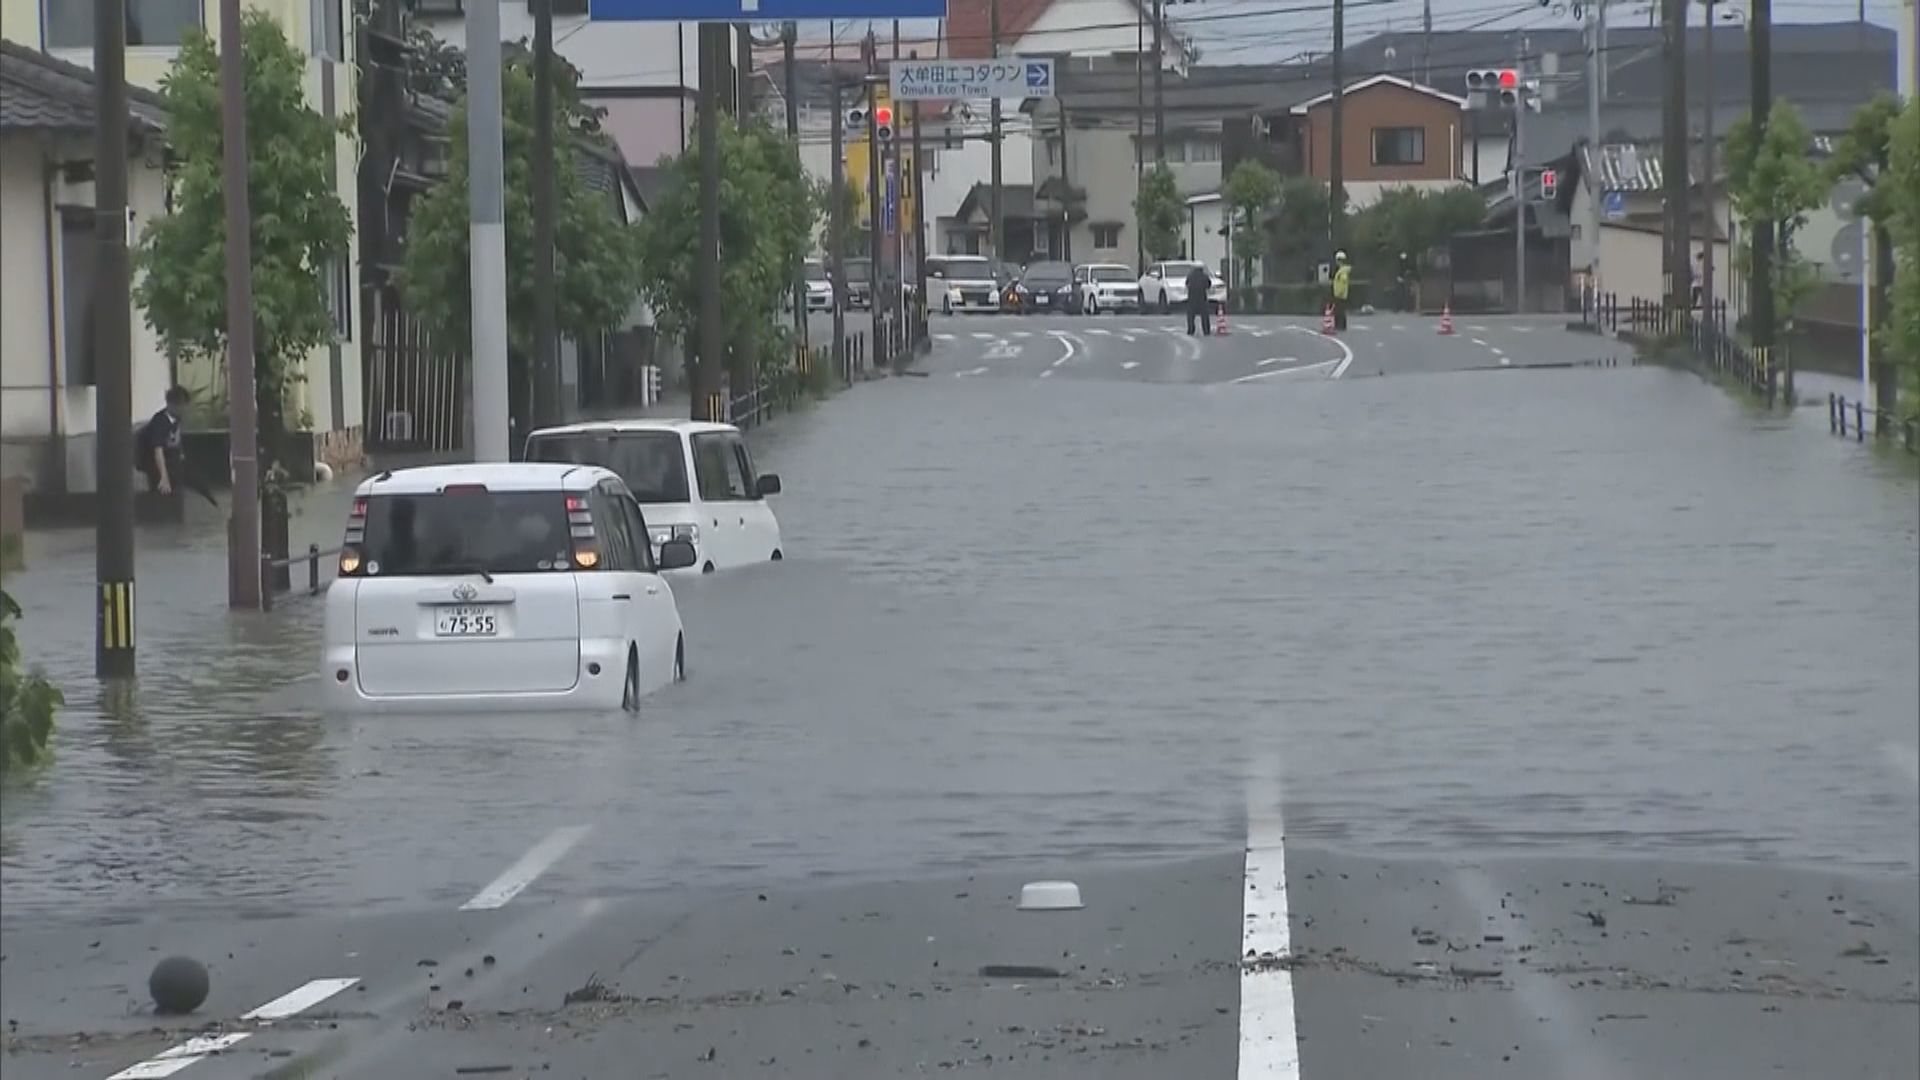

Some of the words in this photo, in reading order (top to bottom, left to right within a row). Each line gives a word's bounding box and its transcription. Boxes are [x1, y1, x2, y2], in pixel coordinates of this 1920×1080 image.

[900, 64, 1022, 83] 大牟田エコタウン
[900, 84, 934, 96] Omuta
[937, 84, 957, 95] Eco
[961, 84, 988, 95] Town
